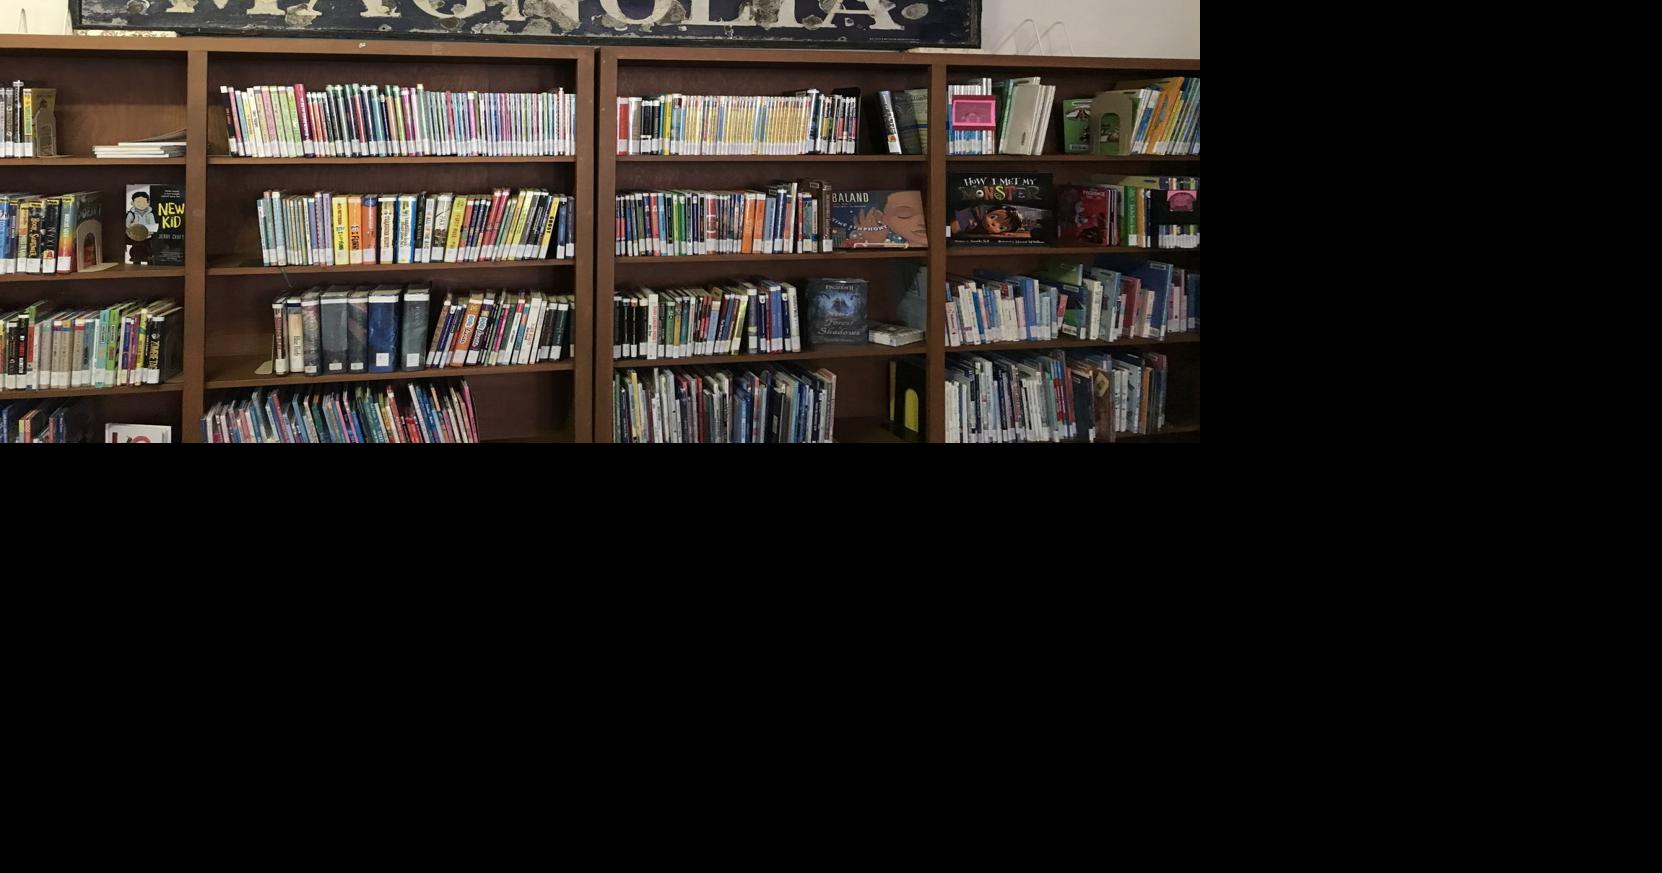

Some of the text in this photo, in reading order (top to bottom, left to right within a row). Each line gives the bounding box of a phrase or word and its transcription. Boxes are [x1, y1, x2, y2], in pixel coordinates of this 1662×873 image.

[958, 186, 1041, 200] MONSTER
[158, 202, 185, 216] NEW
[546, 216, 554, 233] GHOST
[352, 236, 360, 250] FUNN
[150, 341, 160, 361] ZOMBIE
